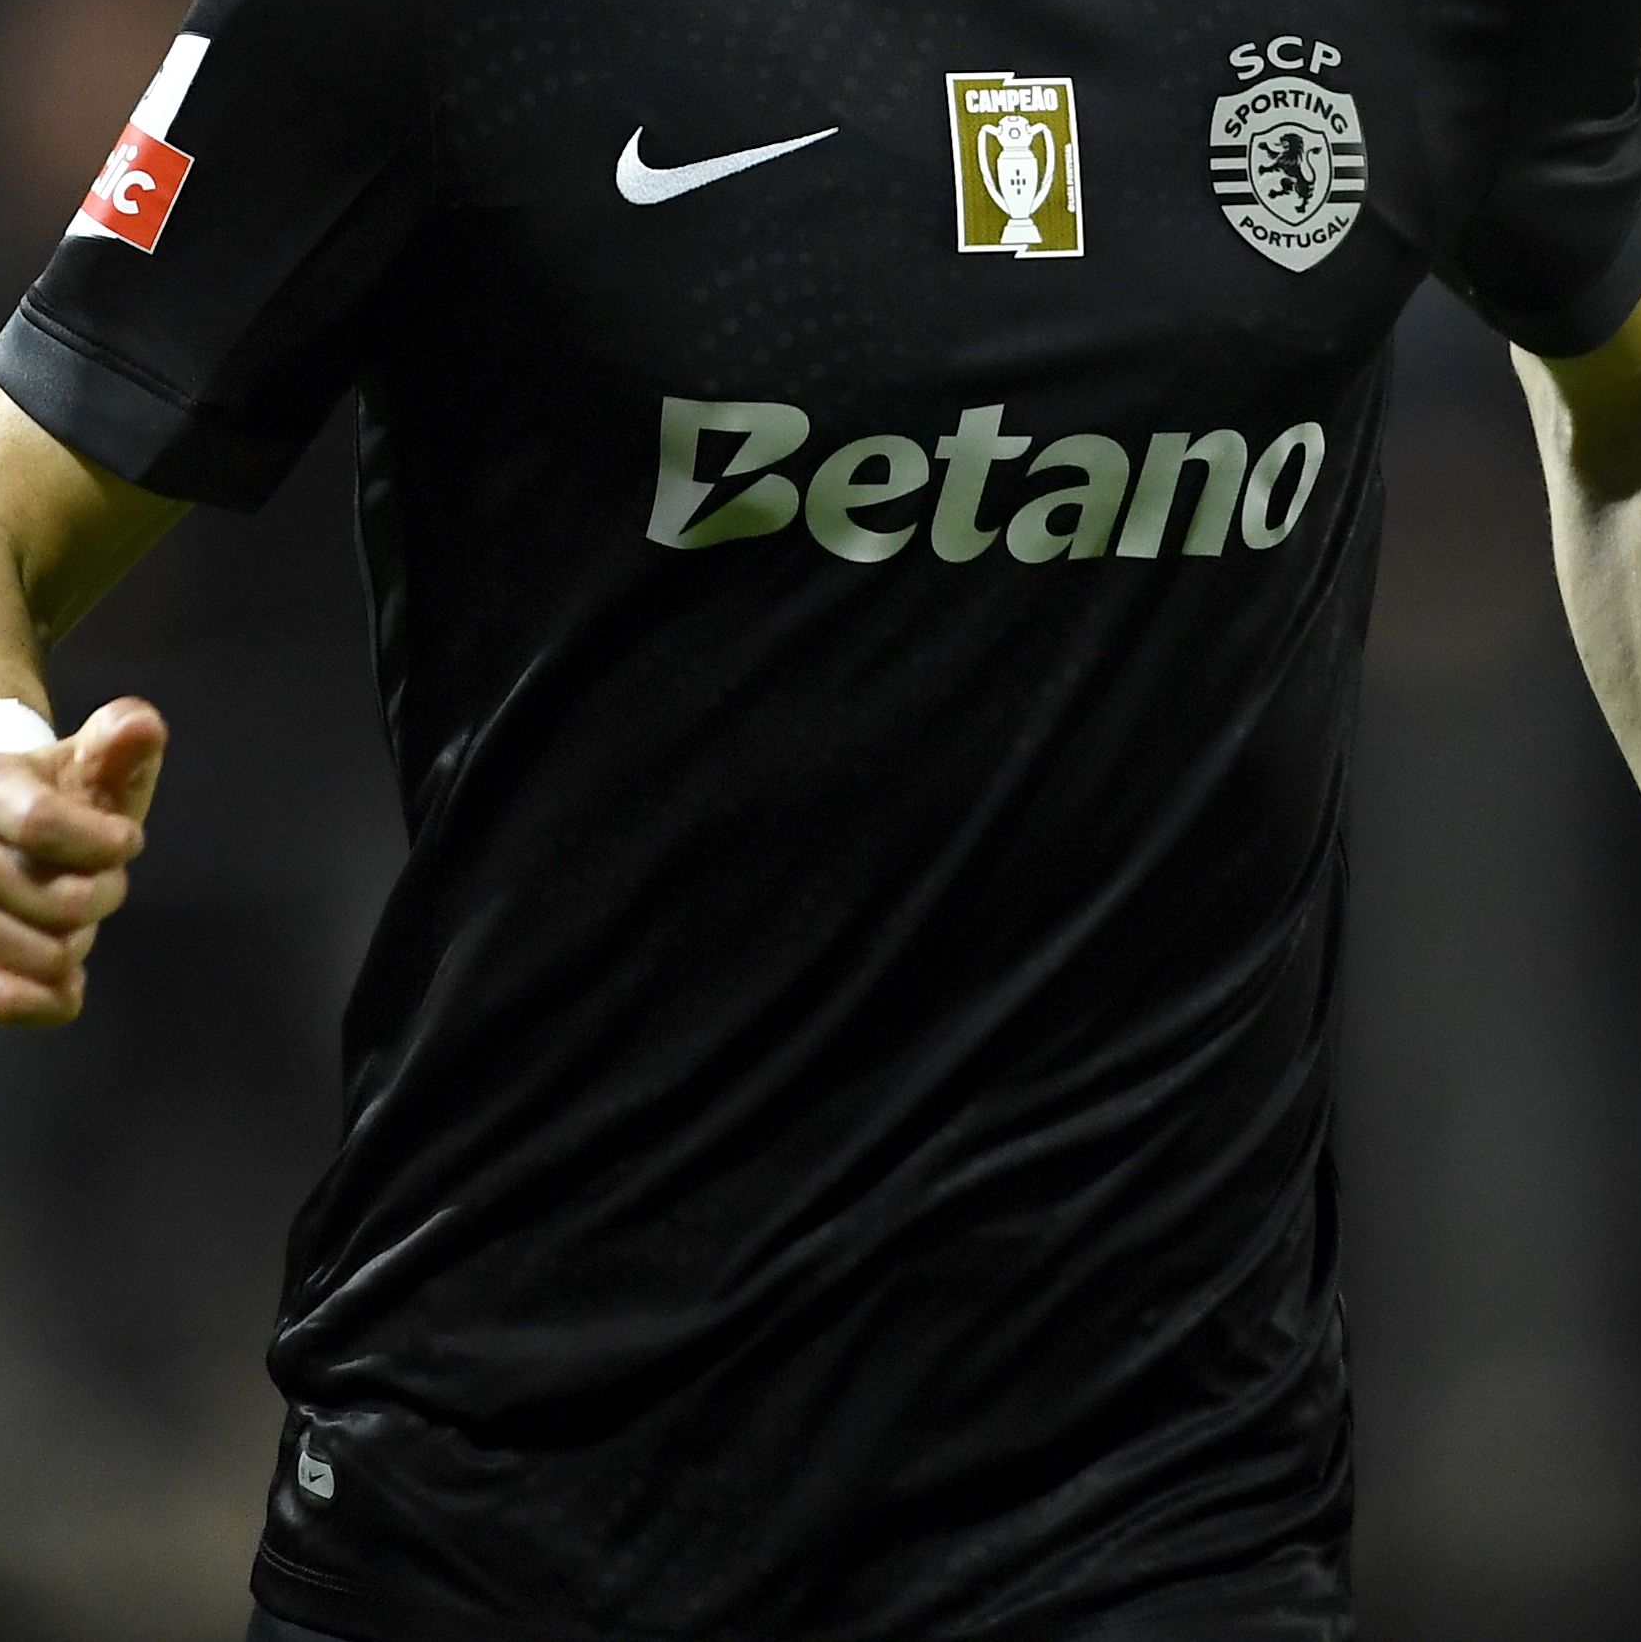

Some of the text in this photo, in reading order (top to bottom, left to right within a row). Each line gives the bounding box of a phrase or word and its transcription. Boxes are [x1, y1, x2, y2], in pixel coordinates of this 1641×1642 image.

[1229, 36, 1341, 80] SCP
[1224, 89, 1348, 138] SPORTING
[1240, 215, 1349, 248] PORTUGAL
[646, 396, 1325, 563] Betano
